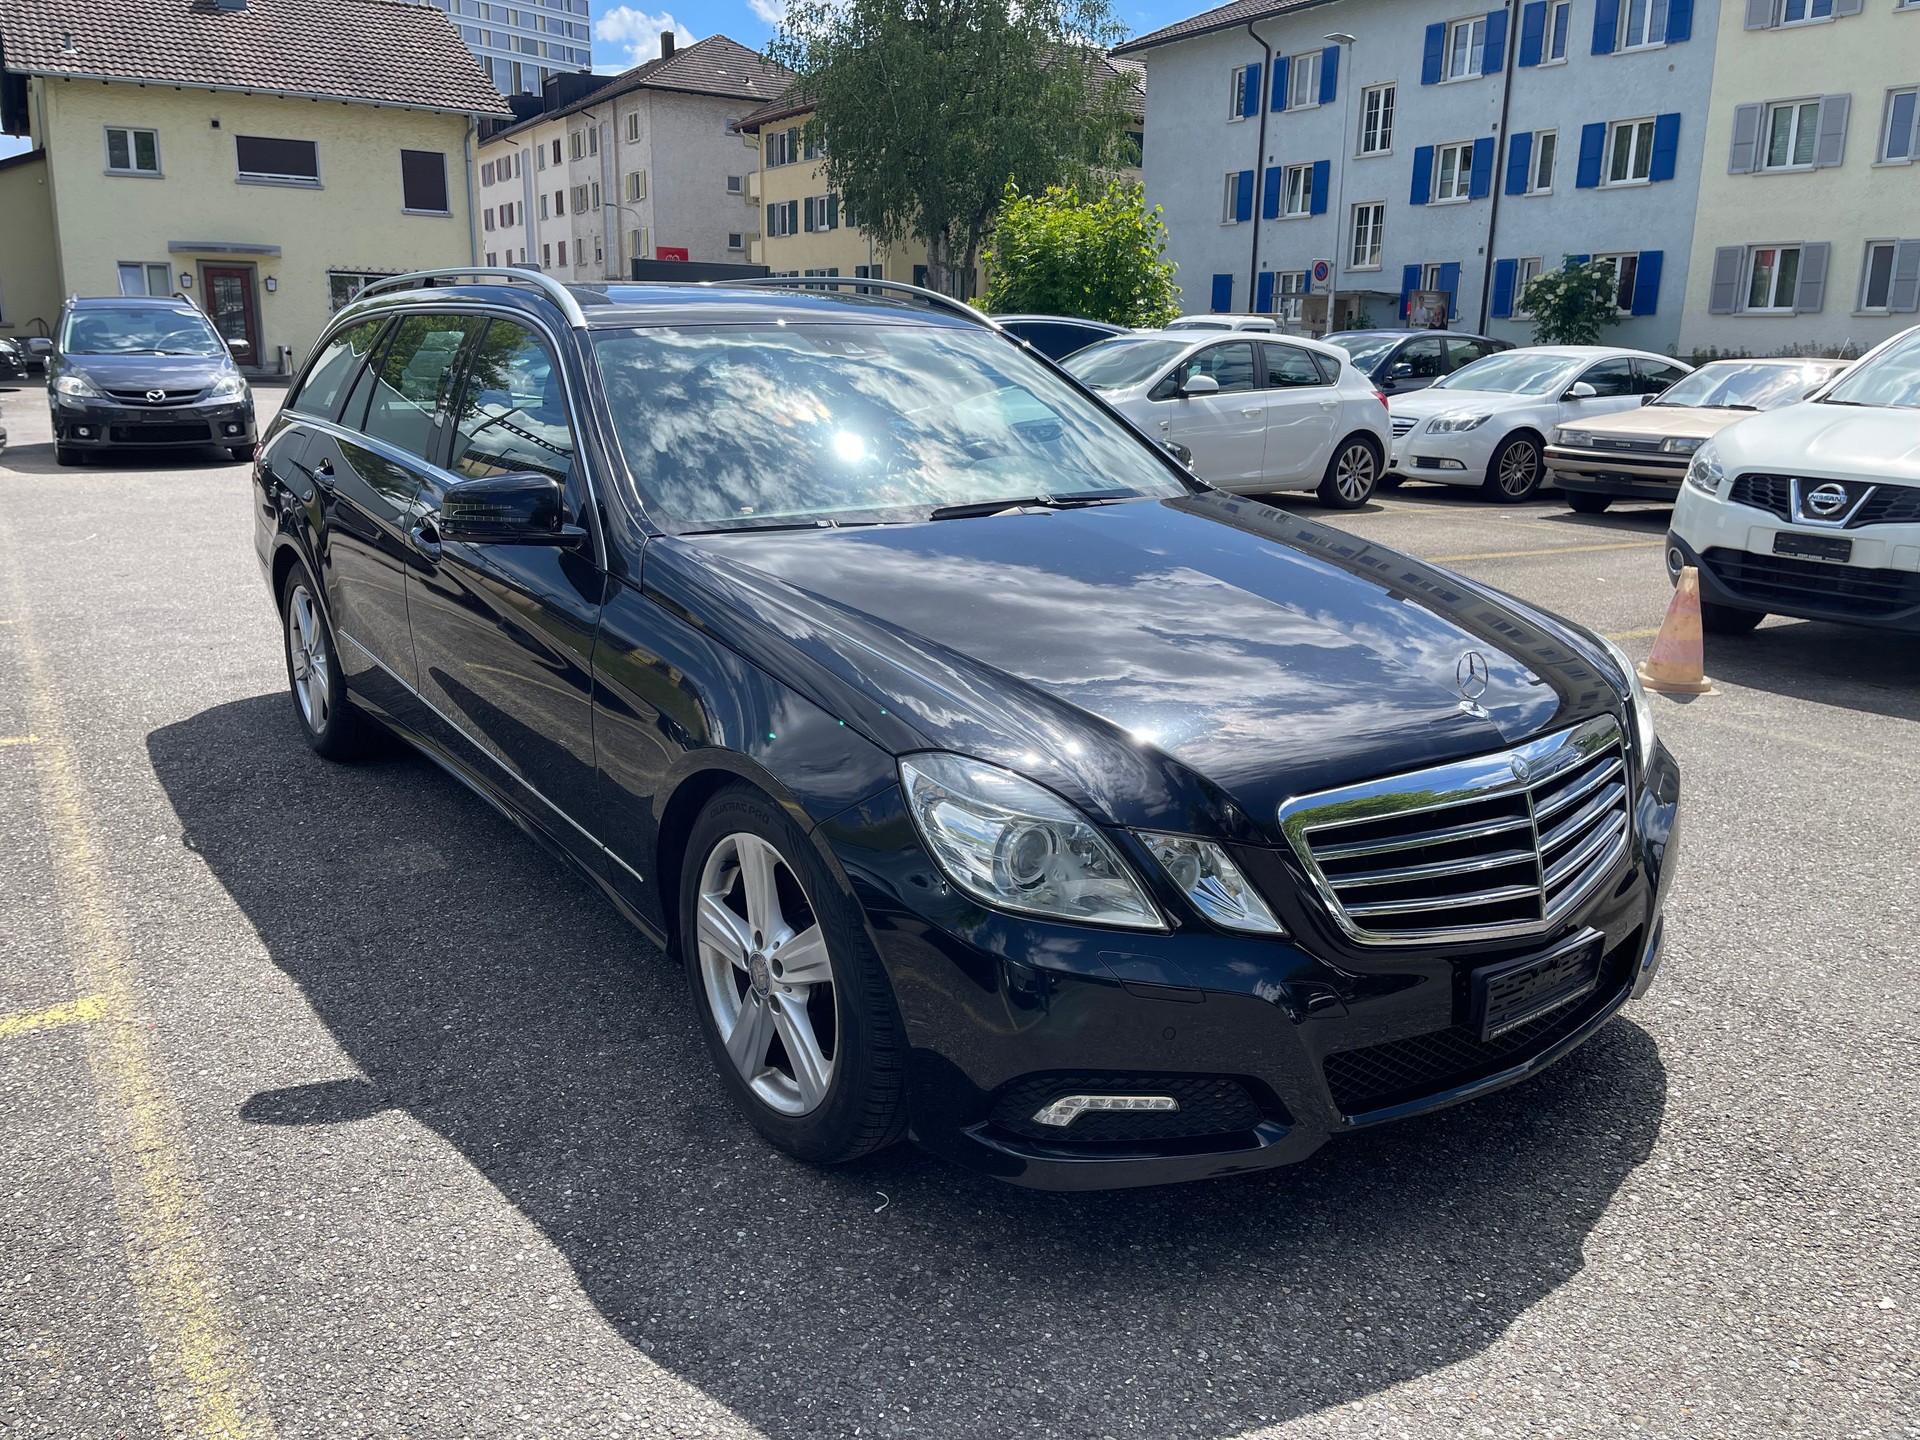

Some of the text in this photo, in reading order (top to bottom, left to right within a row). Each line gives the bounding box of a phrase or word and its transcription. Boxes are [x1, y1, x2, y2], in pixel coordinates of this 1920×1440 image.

[1809, 494, 1842, 502] NISSAN
[710, 802, 770, 825] QUATRAC PRO
